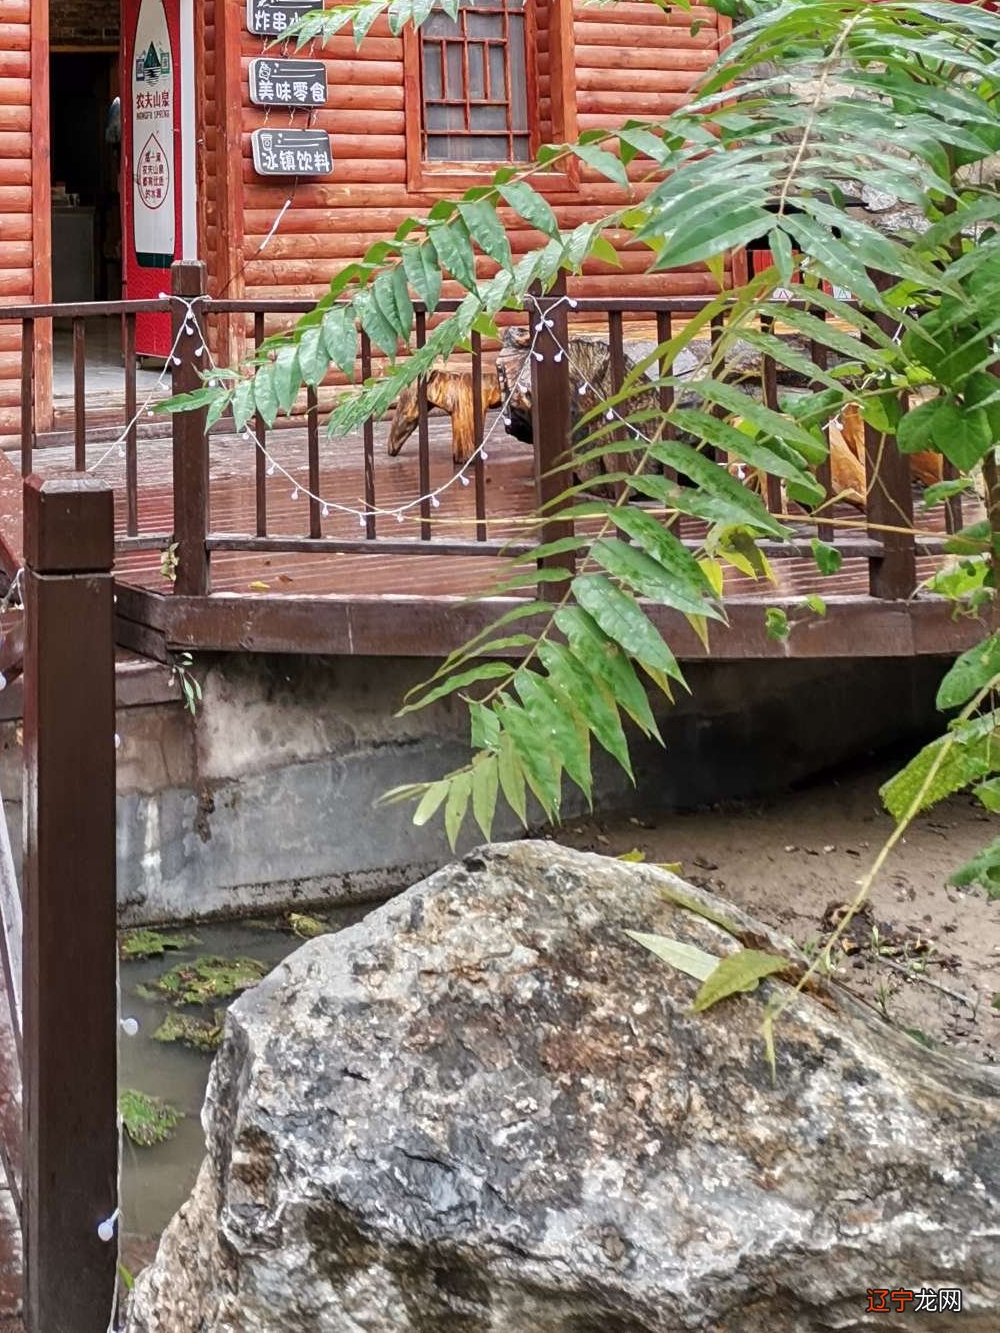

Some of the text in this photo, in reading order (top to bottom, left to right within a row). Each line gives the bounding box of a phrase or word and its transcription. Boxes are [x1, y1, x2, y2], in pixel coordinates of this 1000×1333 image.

[136, 90, 169, 108] 农夫山泉
[258, 80, 326, 102] 美味零食
[261, 150, 330, 172] 冰镇饮料
